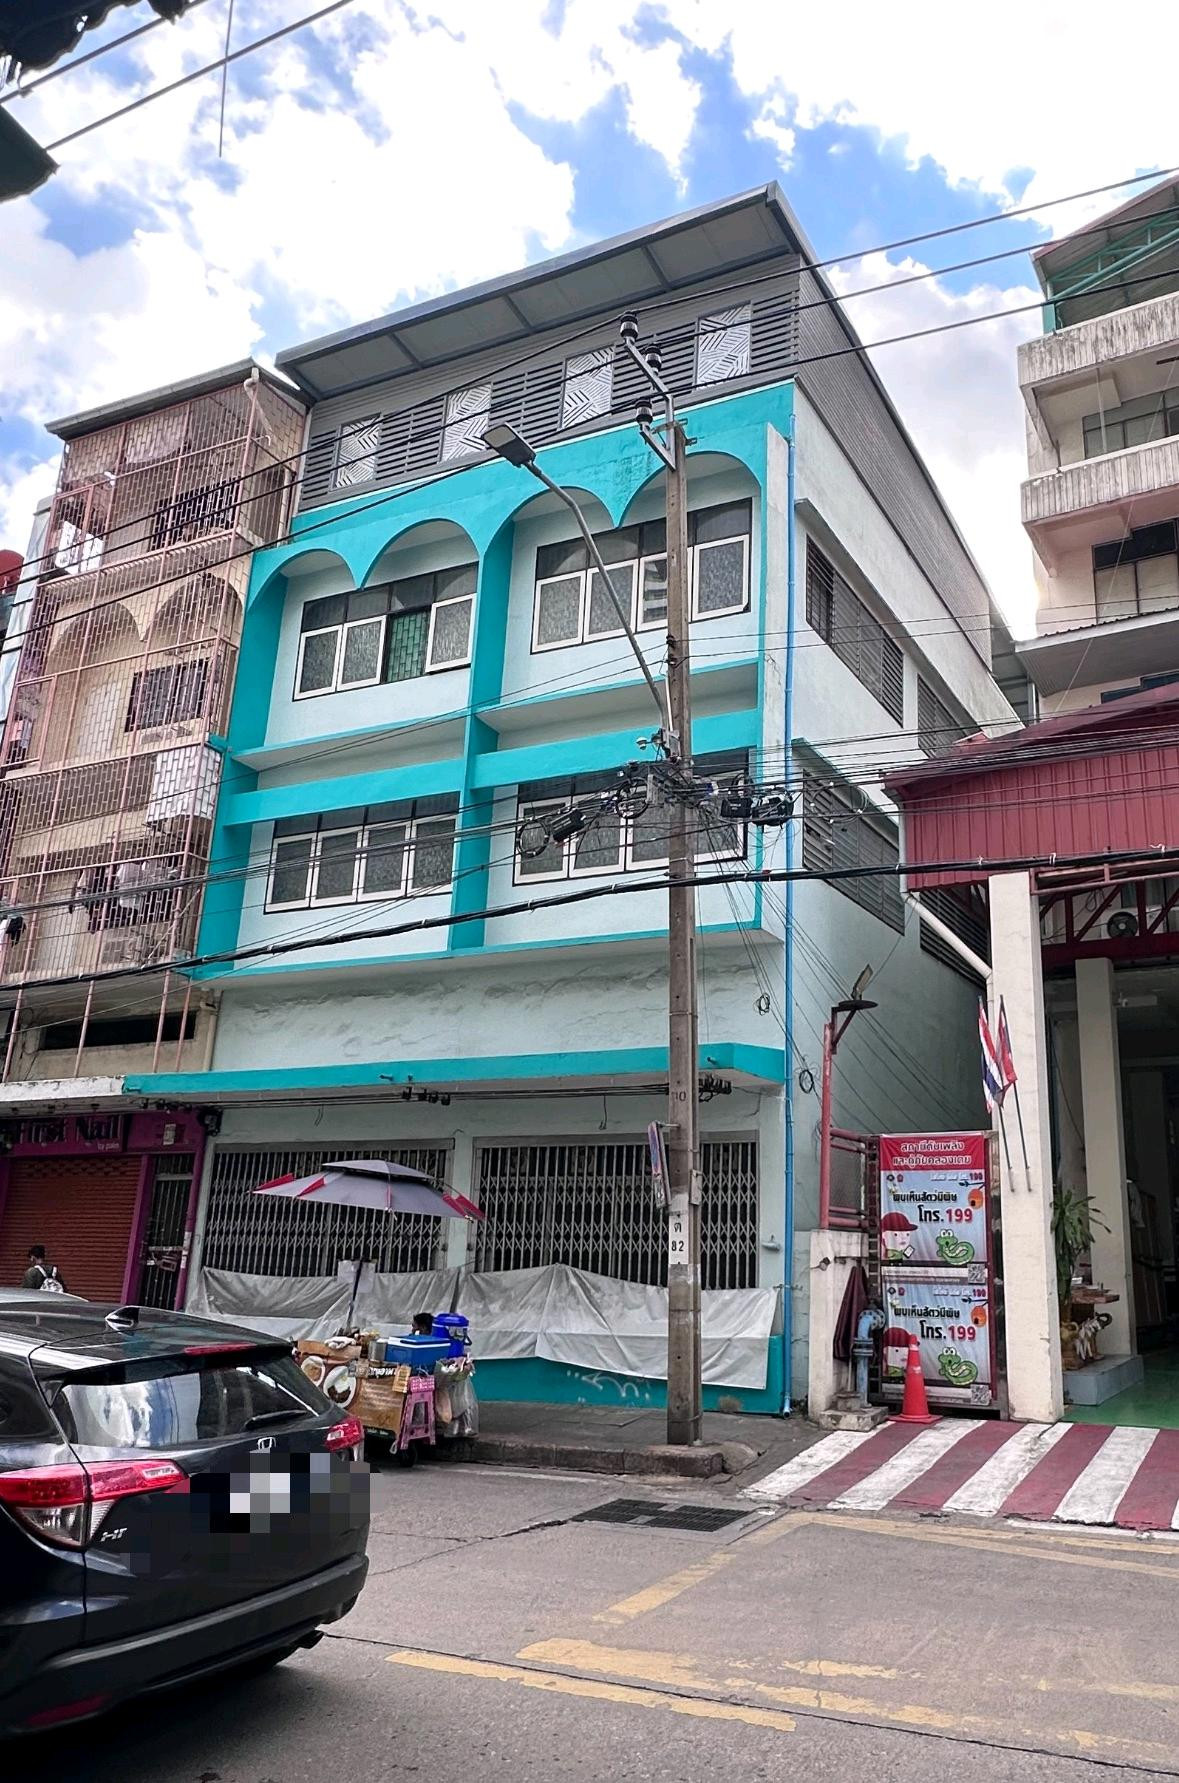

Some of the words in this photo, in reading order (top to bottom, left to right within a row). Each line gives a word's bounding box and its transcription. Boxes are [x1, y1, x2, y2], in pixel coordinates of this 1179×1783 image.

[917, 1204, 944, 1222] โทร.
[946, 1208, 973, 1222] 199
[671, 1240, 685, 1252] 82
[919, 1320, 946, 1339] โทร.
[948, 1325, 977, 1341] 199
